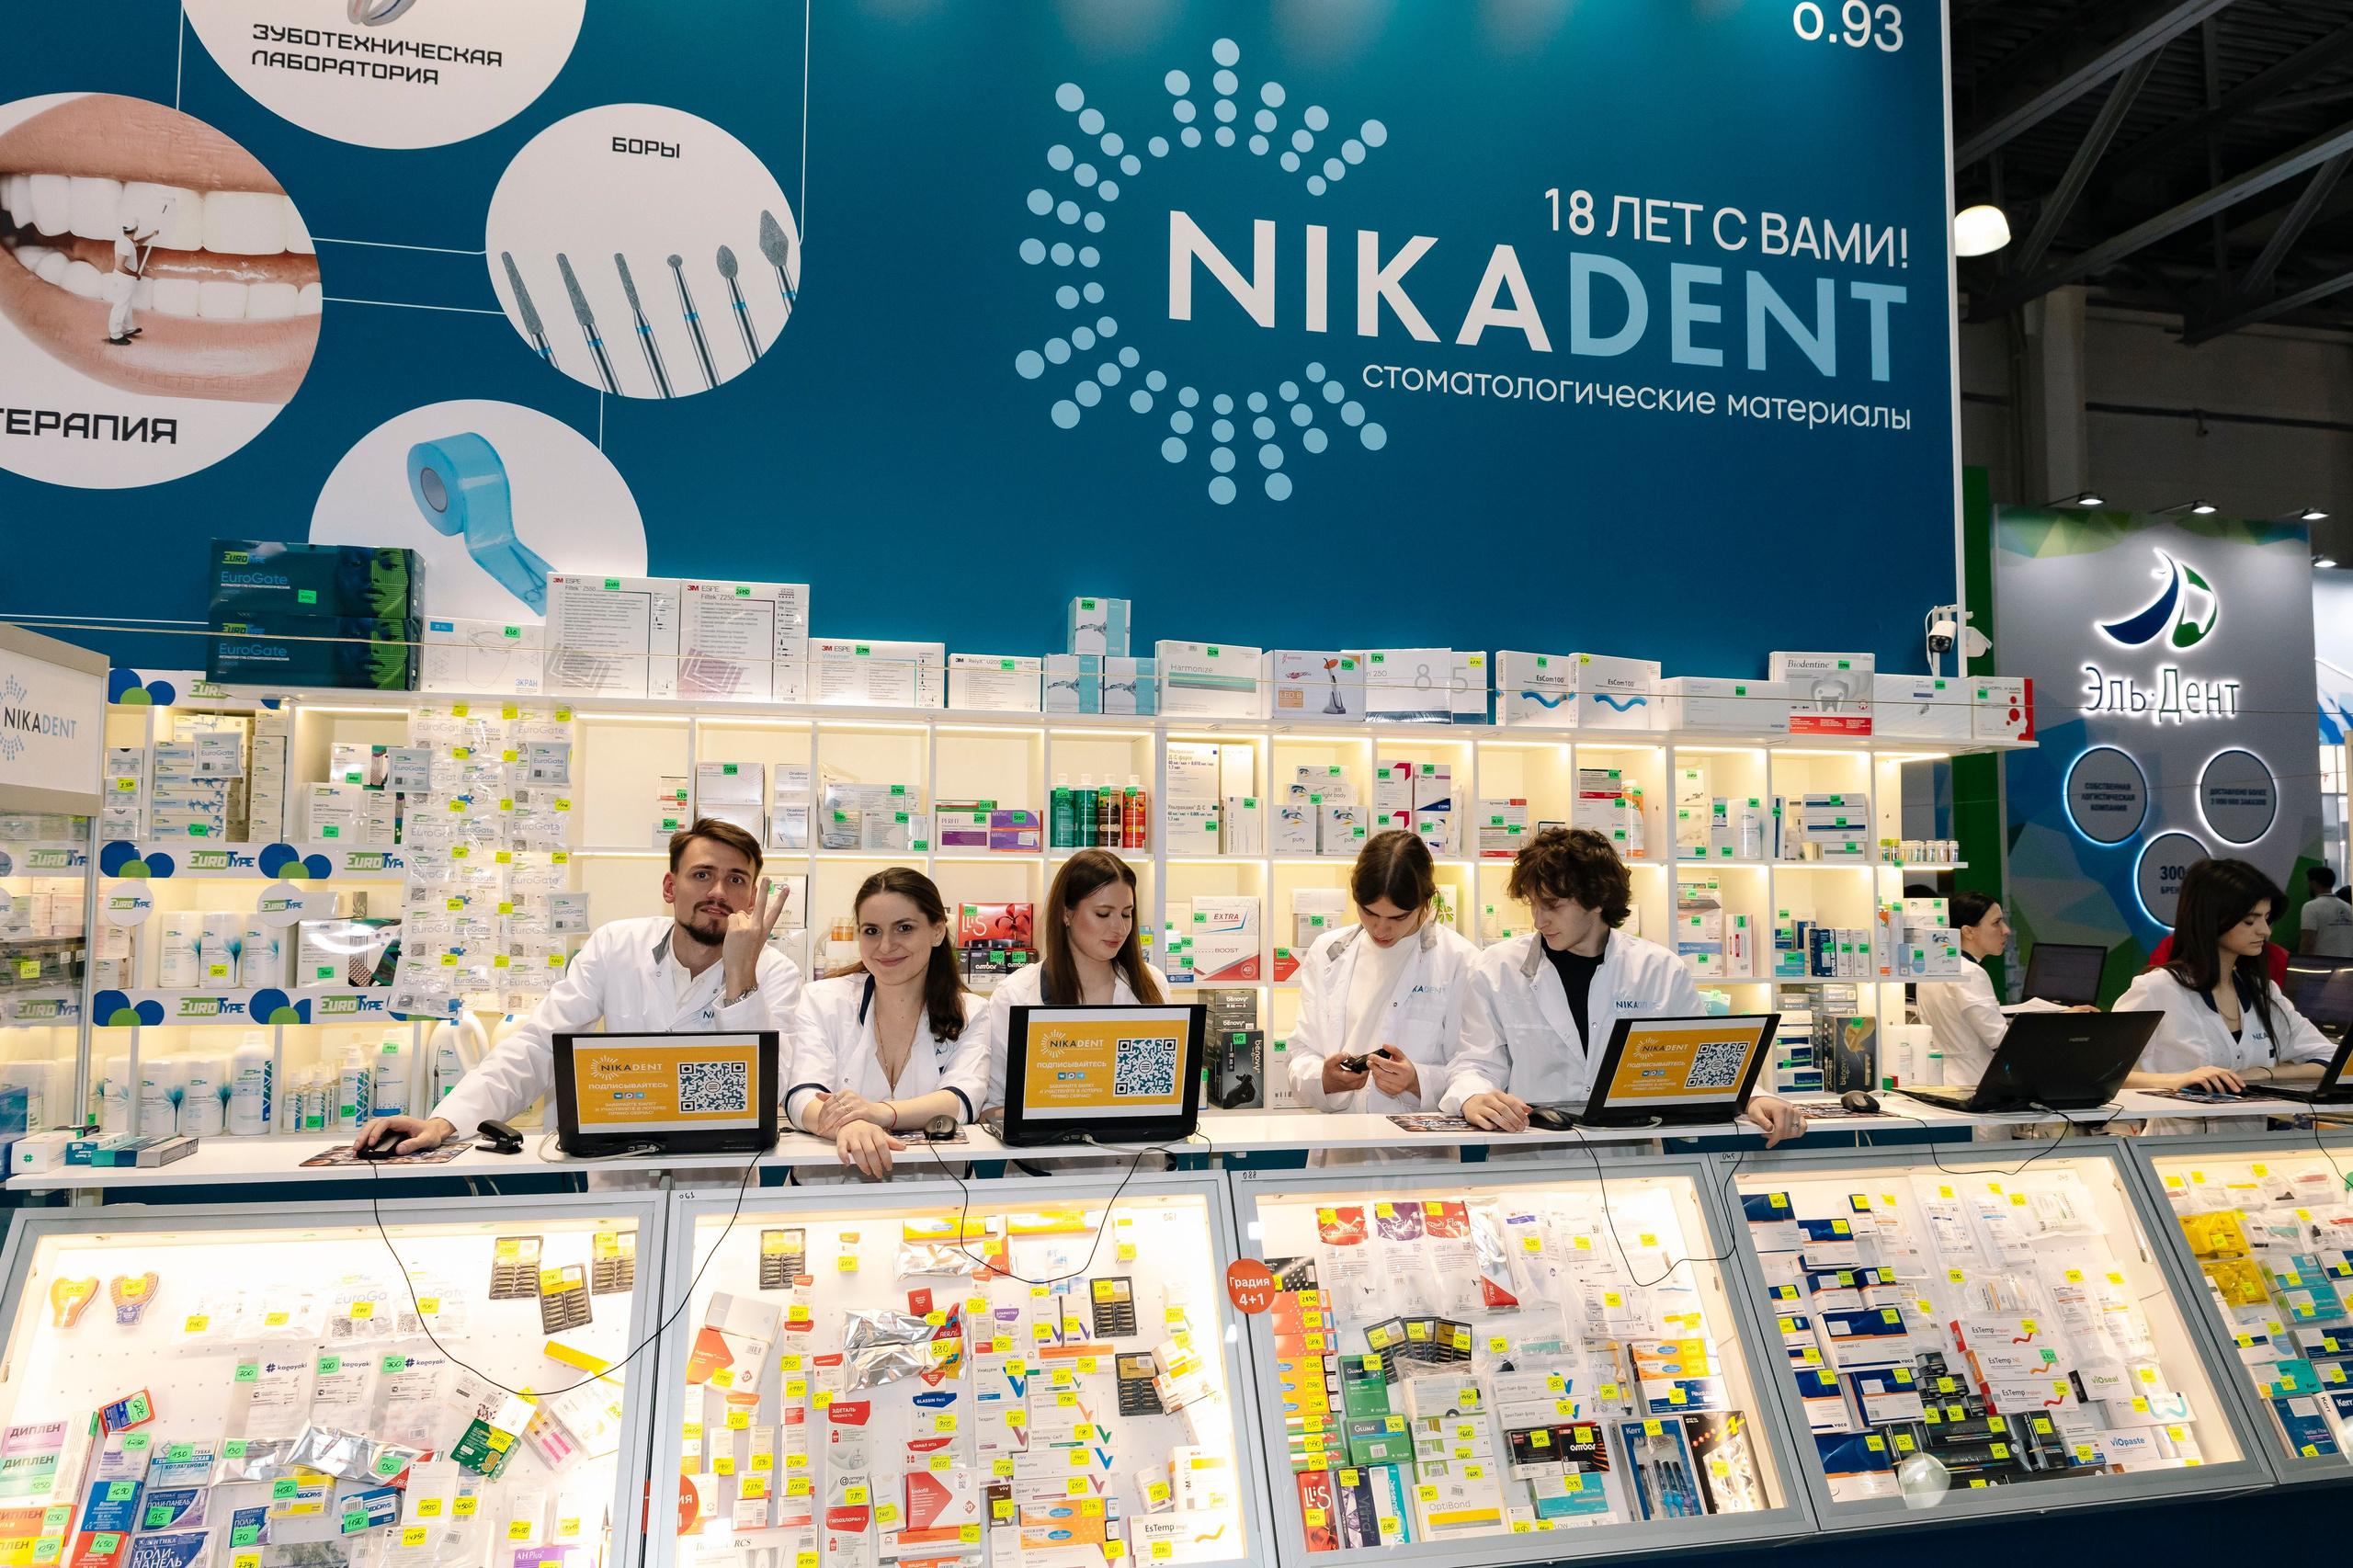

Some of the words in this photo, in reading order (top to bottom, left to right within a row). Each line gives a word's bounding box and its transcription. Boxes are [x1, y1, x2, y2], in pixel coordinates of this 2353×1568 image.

[1792, 0, 1904, 52] 0.93
[252, 23, 503, 67] ЗУБОТЕХНИЧЕСКАЯ
[252, 50, 438, 85] ЛАБОРАТОРИЯ
[611, 136, 680, 159] БОРЫ
[1544, 188, 1595, 236] 18
[1606, 193, 1702, 246] ЛЕТ
[1713, 206, 1746, 248] С
[1760, 210, 1909, 268] ВАМИ!
[1168, 210, 1907, 383] NIKADENT
[1361, 362, 1717, 417] стоматологические
[1726, 391, 1912, 432] материалы
[221, 571, 288, 585] EuroGate
[219, 643, 288, 657] EuroGate
[1170, 664, 1213, 673] Harmonize
[516, 678, 538, 687] ЭКРАН
[1415, 664, 1432, 691] 8
[1537, 675, 1564, 683] EsCom100
[1608, 678, 1635, 687] EsCom100
[5, 706, 76, 740] NIKADENT
[518, 725, 564, 735] EuroGate
[2085, 782, 2131, 790] СОБСТВЕННАЯ
[2081, 793, 2135, 801] ЛОГИСТИЧЕСКАЯ
[2090, 803, 2127, 812] КОМПАНИЯ
[1051, 1040, 1104, 1048] NIKADENT
[1643, 1043, 1688, 1052] NIKADENT
[600, 1063, 663, 1072] NIKADENT
[1037, 1061, 1107, 1069] ПОДПИСЫВАЙТЕСЬ
[1229, 1276, 1270, 1290] Градия
[1239, 1293, 1265, 1305] 4+1
[278, 1363, 308, 1371] kagayaki
[320, 1361, 335, 1369] 700
[10, 1424, 61, 1438] ДИПЛЕН
[1626, 1426, 1641, 1435] Kerr
[3, 1456, 53, 1470] ДИПЛЕН
[165, 1461, 209, 1470] КОЛЛАГЕНОВАЯ
[481, 1451, 500, 1473] 9
[147, 1498, 190, 1508] ПОЛИ-ПАНЕЛЬ
[1428, 1500, 1471, 1511] OptiBond
[152, 1513, 164, 1522] 95
[233, 1518, 256, 1527] ПОЛИ-
[734, 1539, 751, 1547] RCS
[135, 1550, 176, 1562] ПОЛИ-
